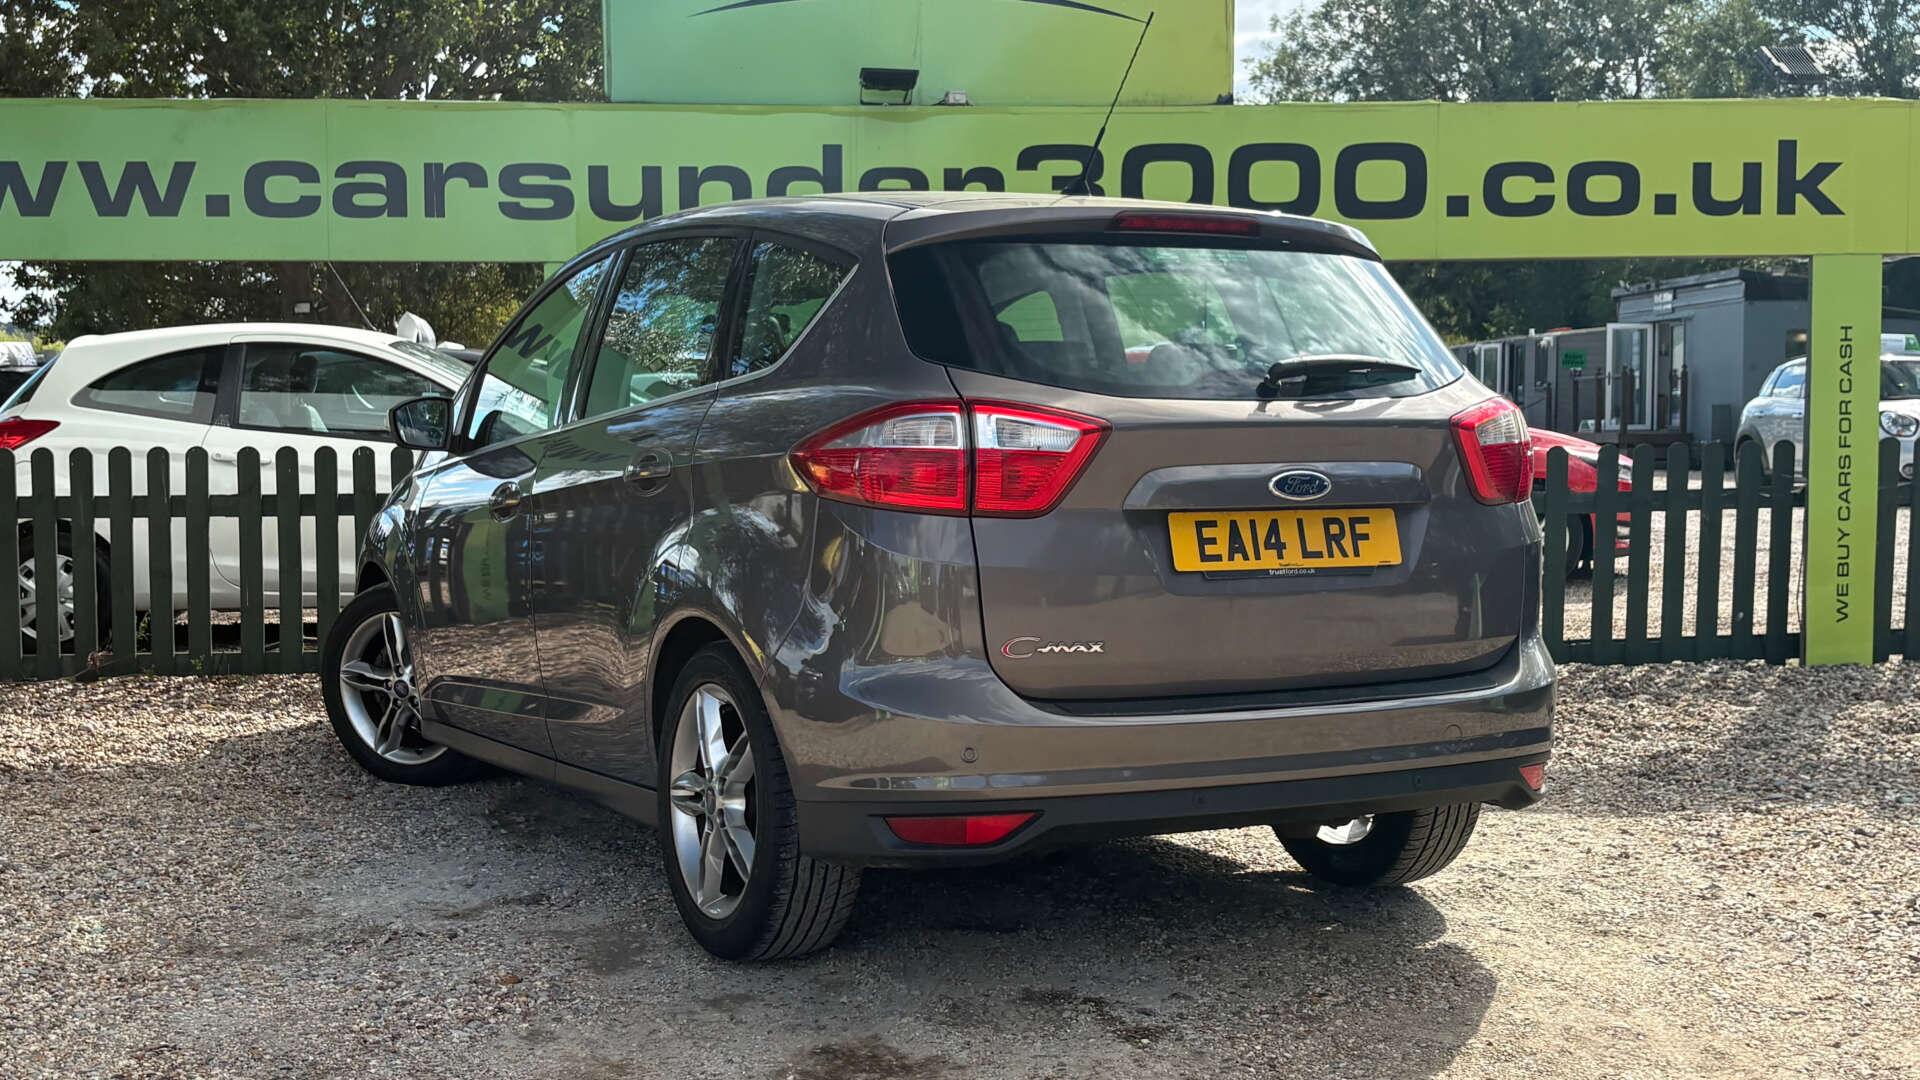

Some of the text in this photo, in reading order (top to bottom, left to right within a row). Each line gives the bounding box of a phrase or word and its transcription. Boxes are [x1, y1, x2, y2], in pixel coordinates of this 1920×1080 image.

[1195, 516, 1371, 563] EA14 LRF
[1836, 326, 1853, 623] WE BUY CARS FOR CASH
